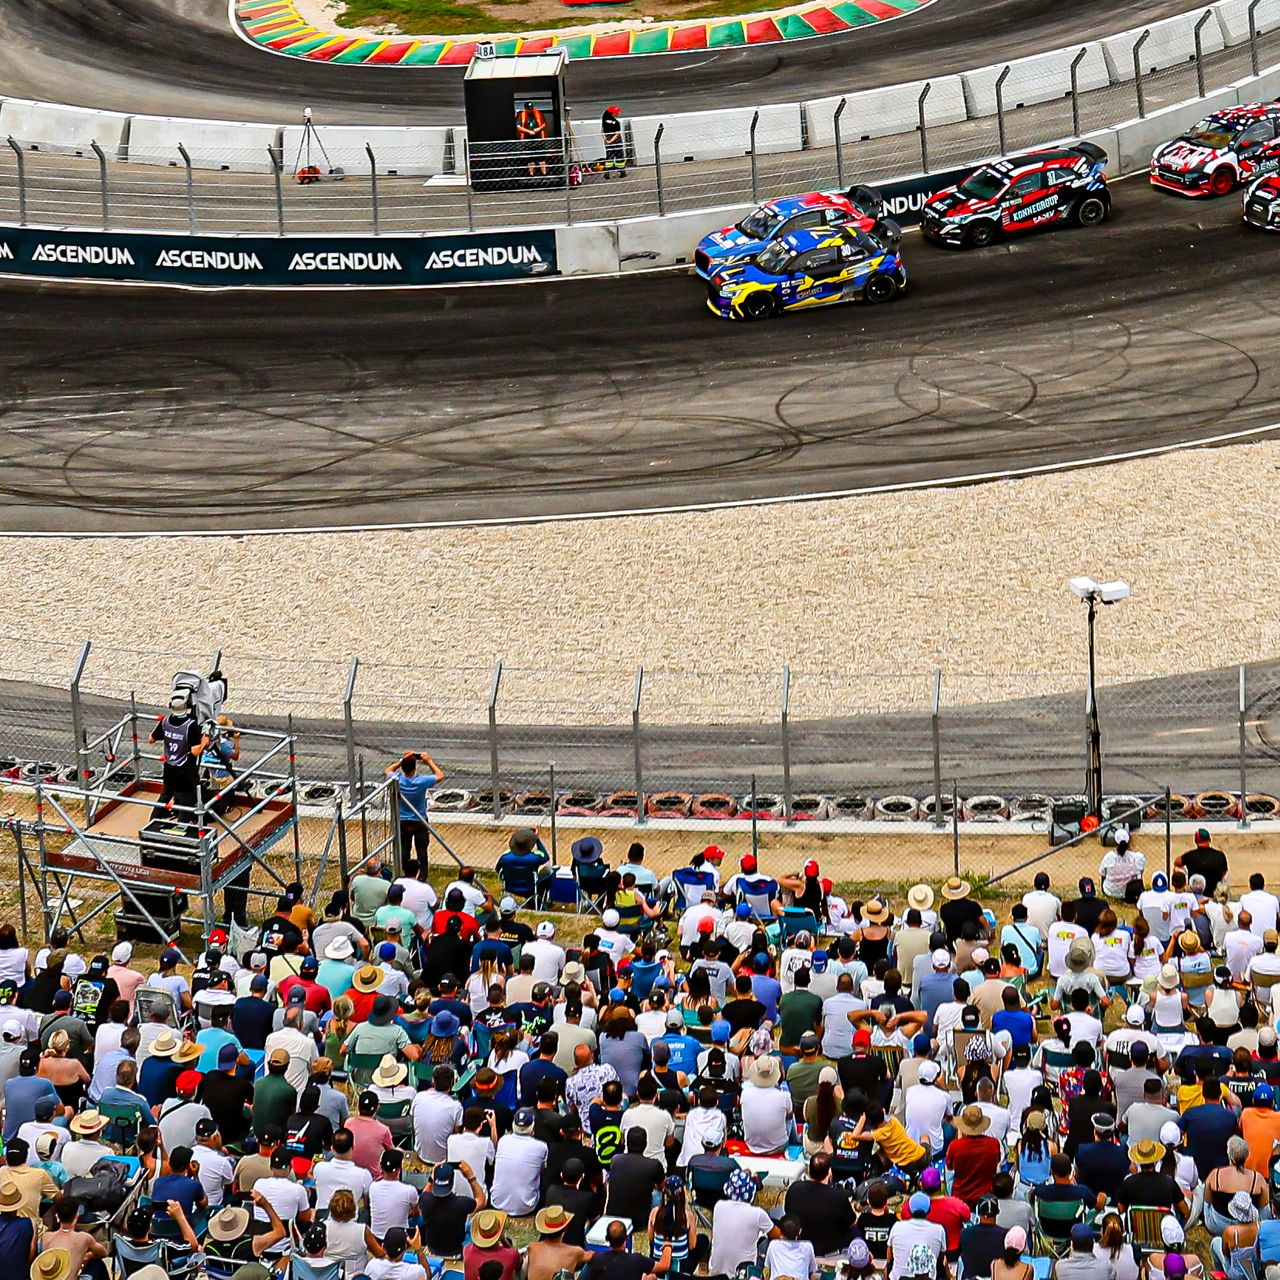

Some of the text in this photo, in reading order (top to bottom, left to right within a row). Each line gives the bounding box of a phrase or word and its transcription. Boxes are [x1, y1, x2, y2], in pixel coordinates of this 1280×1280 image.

[1012, 194, 1059, 222] KONNEGROUP
[32, 243, 135, 266] ASCENDUM
[156, 249, 263, 270] ASCENDUM
[288, 252, 402, 271] ASCENDUM
[425, 245, 542, 270] ASCENDUM
